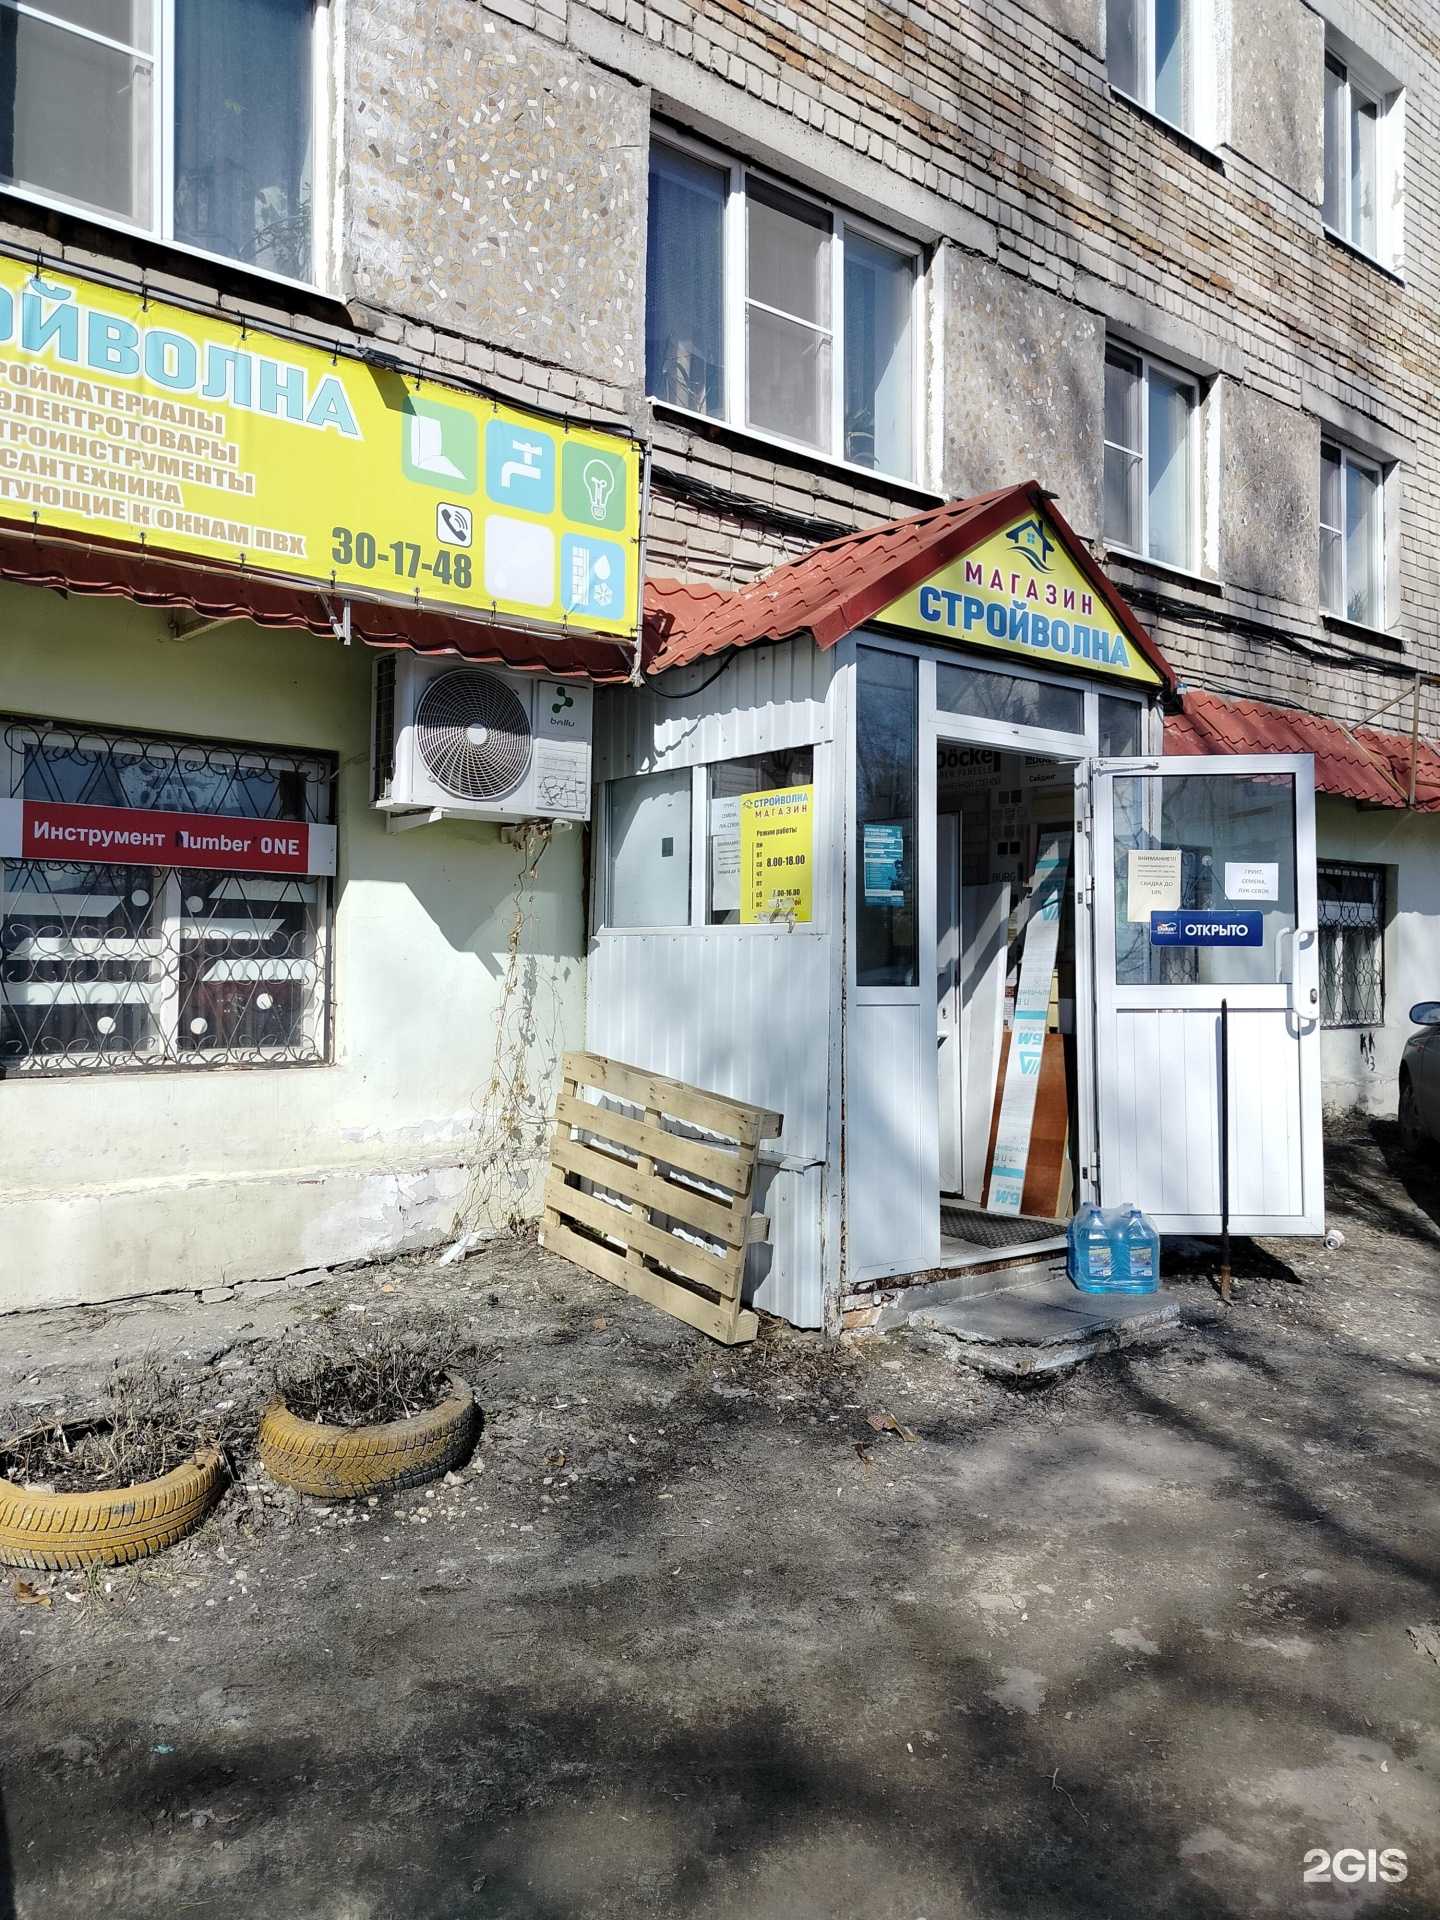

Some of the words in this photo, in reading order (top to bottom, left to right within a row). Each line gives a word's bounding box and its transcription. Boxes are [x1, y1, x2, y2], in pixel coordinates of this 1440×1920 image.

[0, 277, 358, 435] ЙВОЛНА
[0, 448, 182, 505] САНТЕХНИКА
[132, 504, 150, 526] К
[156, 508, 249, 546] ОКНАМ
[331, 526, 473, 589] 30-17-48
[964, 560, 1093, 616] МАГАЗИН
[919, 585, 1130, 668] СТРОЙВОЛНА
[754, 792, 808, 808] СТРОЙВОЛНА
[755, 804, 807, 818] МАГАЗИН
[33, 820, 166, 848] Инструмент
[260, 836, 300, 856] ONE
[766, 855, 806, 868] 8.00-18.00
[1184, 924, 1249, 937] ОТКРЫТО
